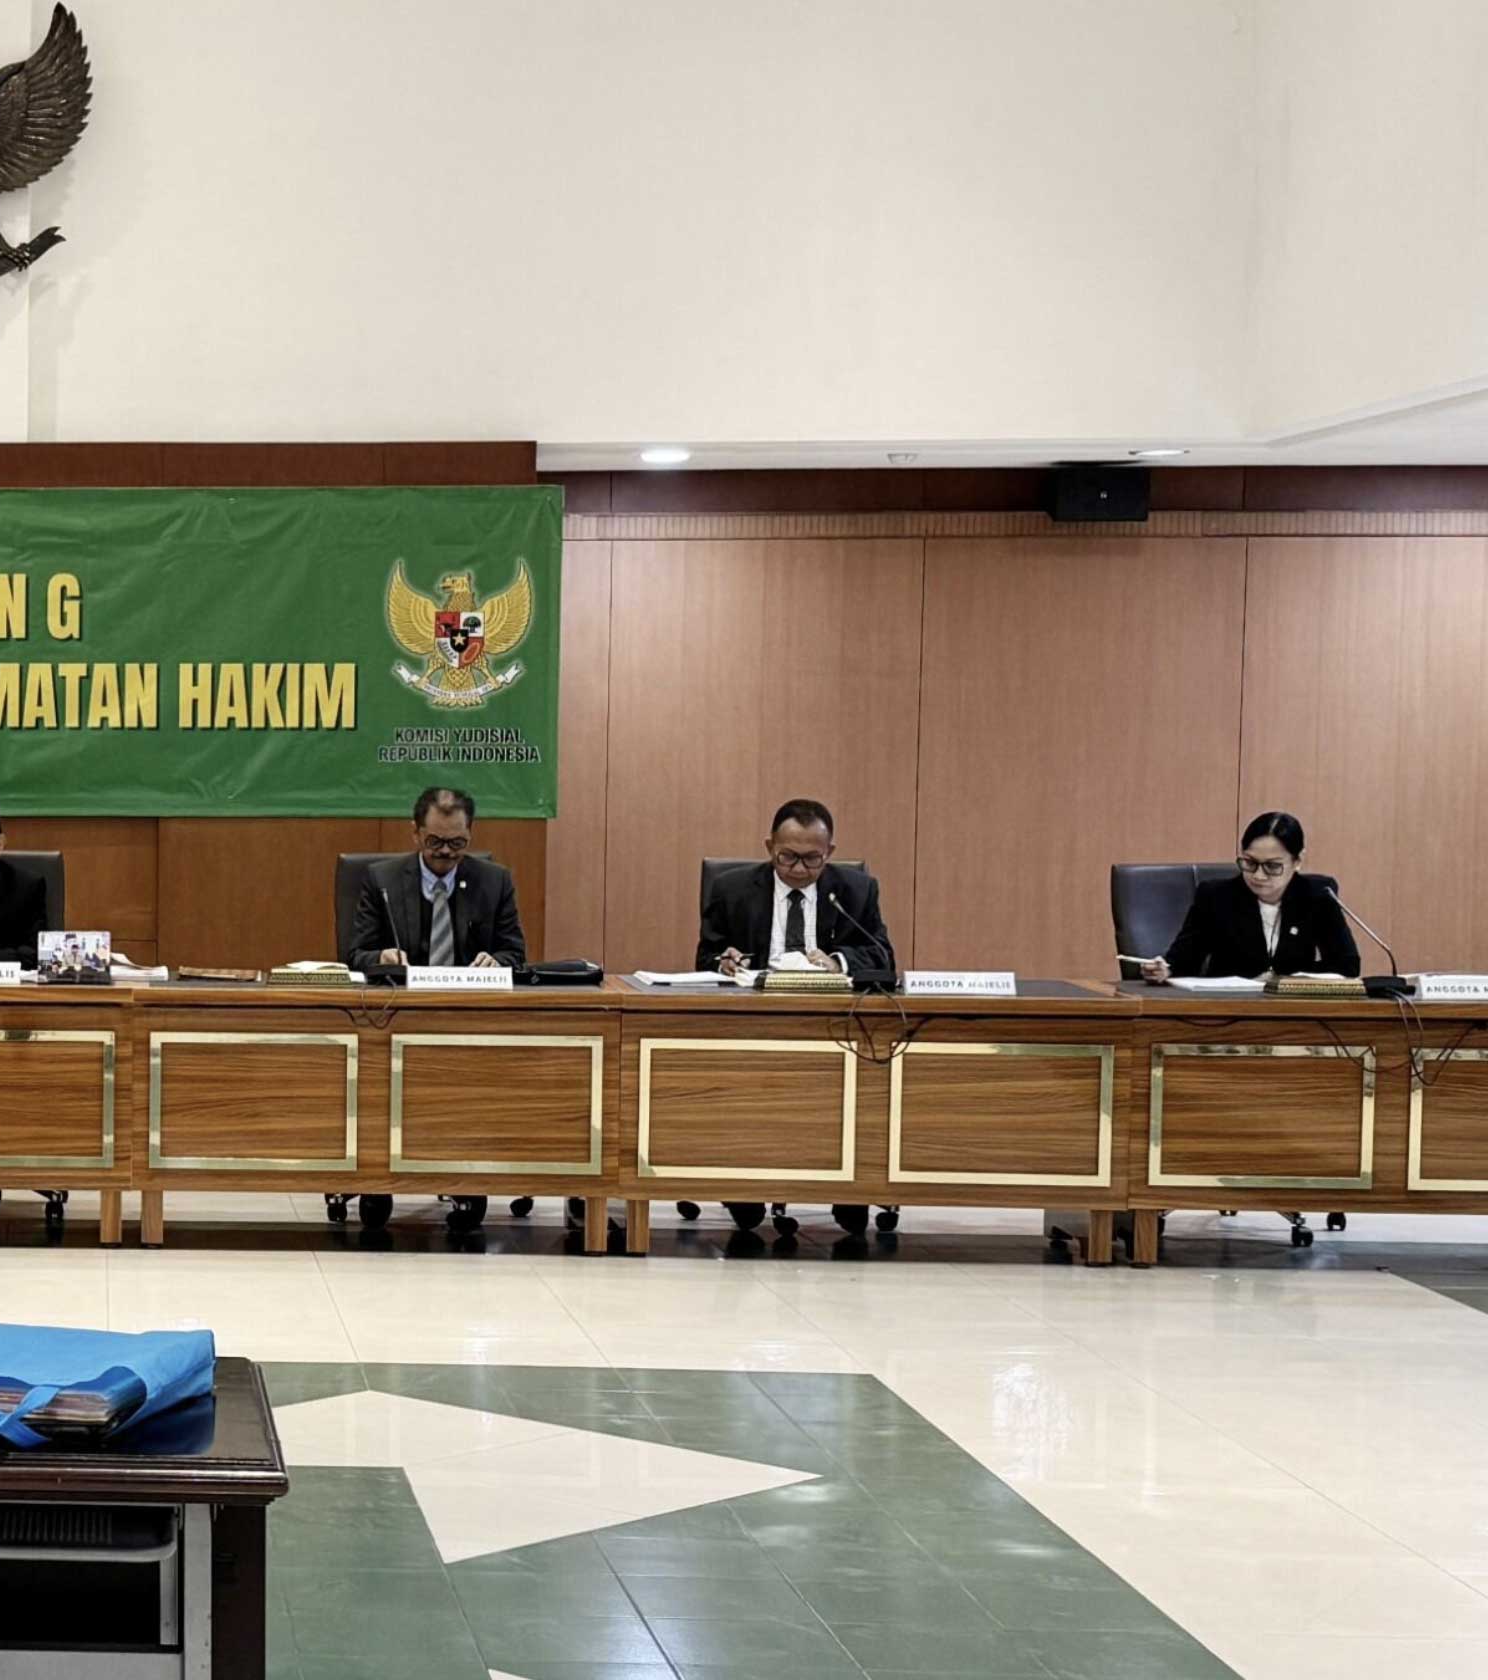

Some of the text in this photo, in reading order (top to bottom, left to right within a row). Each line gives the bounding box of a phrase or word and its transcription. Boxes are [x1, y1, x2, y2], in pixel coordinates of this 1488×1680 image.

[179, 663, 356, 729] HAKIM
[395, 727, 525, 744] KOMISI YUDISIAL
[378, 745, 541, 762] REPUBLIK INDONESIA
[411, 975, 462, 983] ANGGOTA
[910, 980, 964, 988] ANGGOTA
[1426, 985, 1480, 993] ANGGOTA
